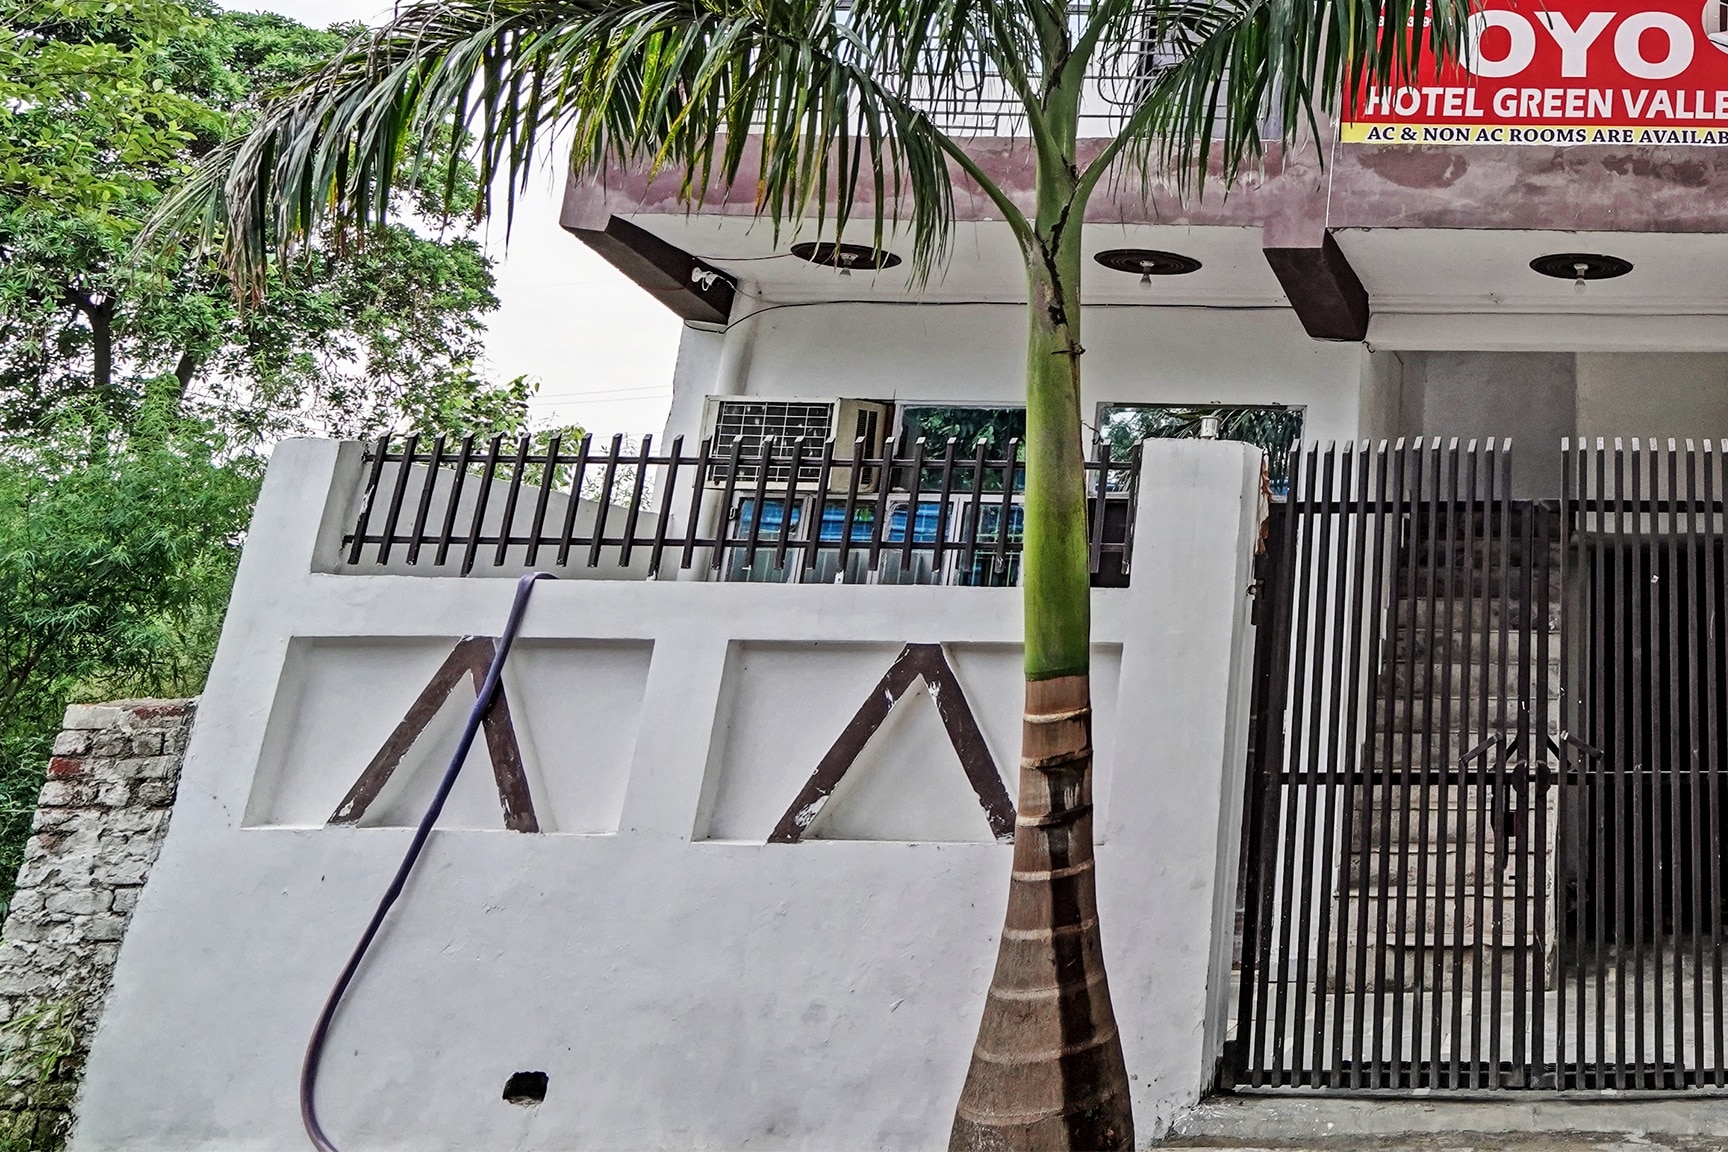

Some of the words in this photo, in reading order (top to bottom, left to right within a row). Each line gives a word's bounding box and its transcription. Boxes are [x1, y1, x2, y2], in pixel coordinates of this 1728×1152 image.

[1459, 10, 1695, 79] OYO
[1366, 86, 1484, 117] HOTEL
[1493, 88, 1613, 118] GREEN
[1368, 127, 1395, 140] AC
[1401, 129, 1417, 141] &
[1423, 128, 1470, 141] NON
[1476, 129, 1503, 142] AC
[1509, 129, 1586, 142] ROOMS
[1592, 130, 1633, 142] ARE
